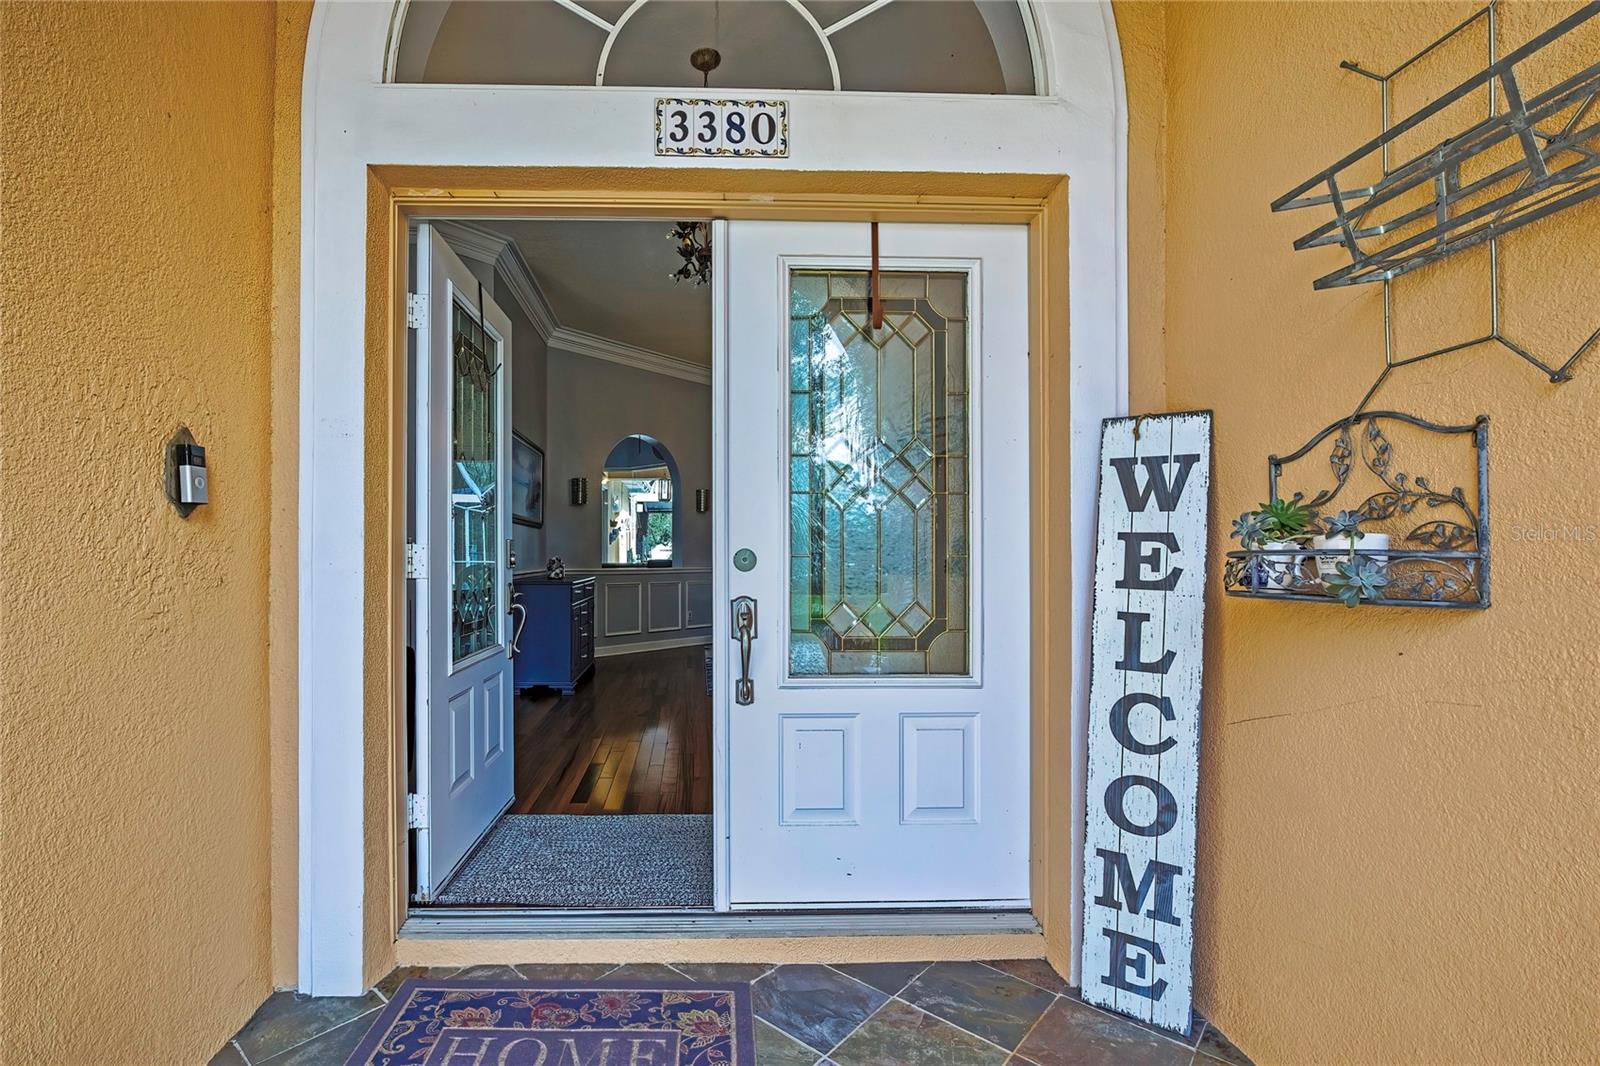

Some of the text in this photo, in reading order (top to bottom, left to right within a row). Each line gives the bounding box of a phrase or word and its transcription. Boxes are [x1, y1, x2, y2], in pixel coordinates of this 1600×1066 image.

[669, 110, 776, 145] 3380
[1094, 453, 1200, 1001] WELCOME
[440, 1036, 668, 1066] HOME
